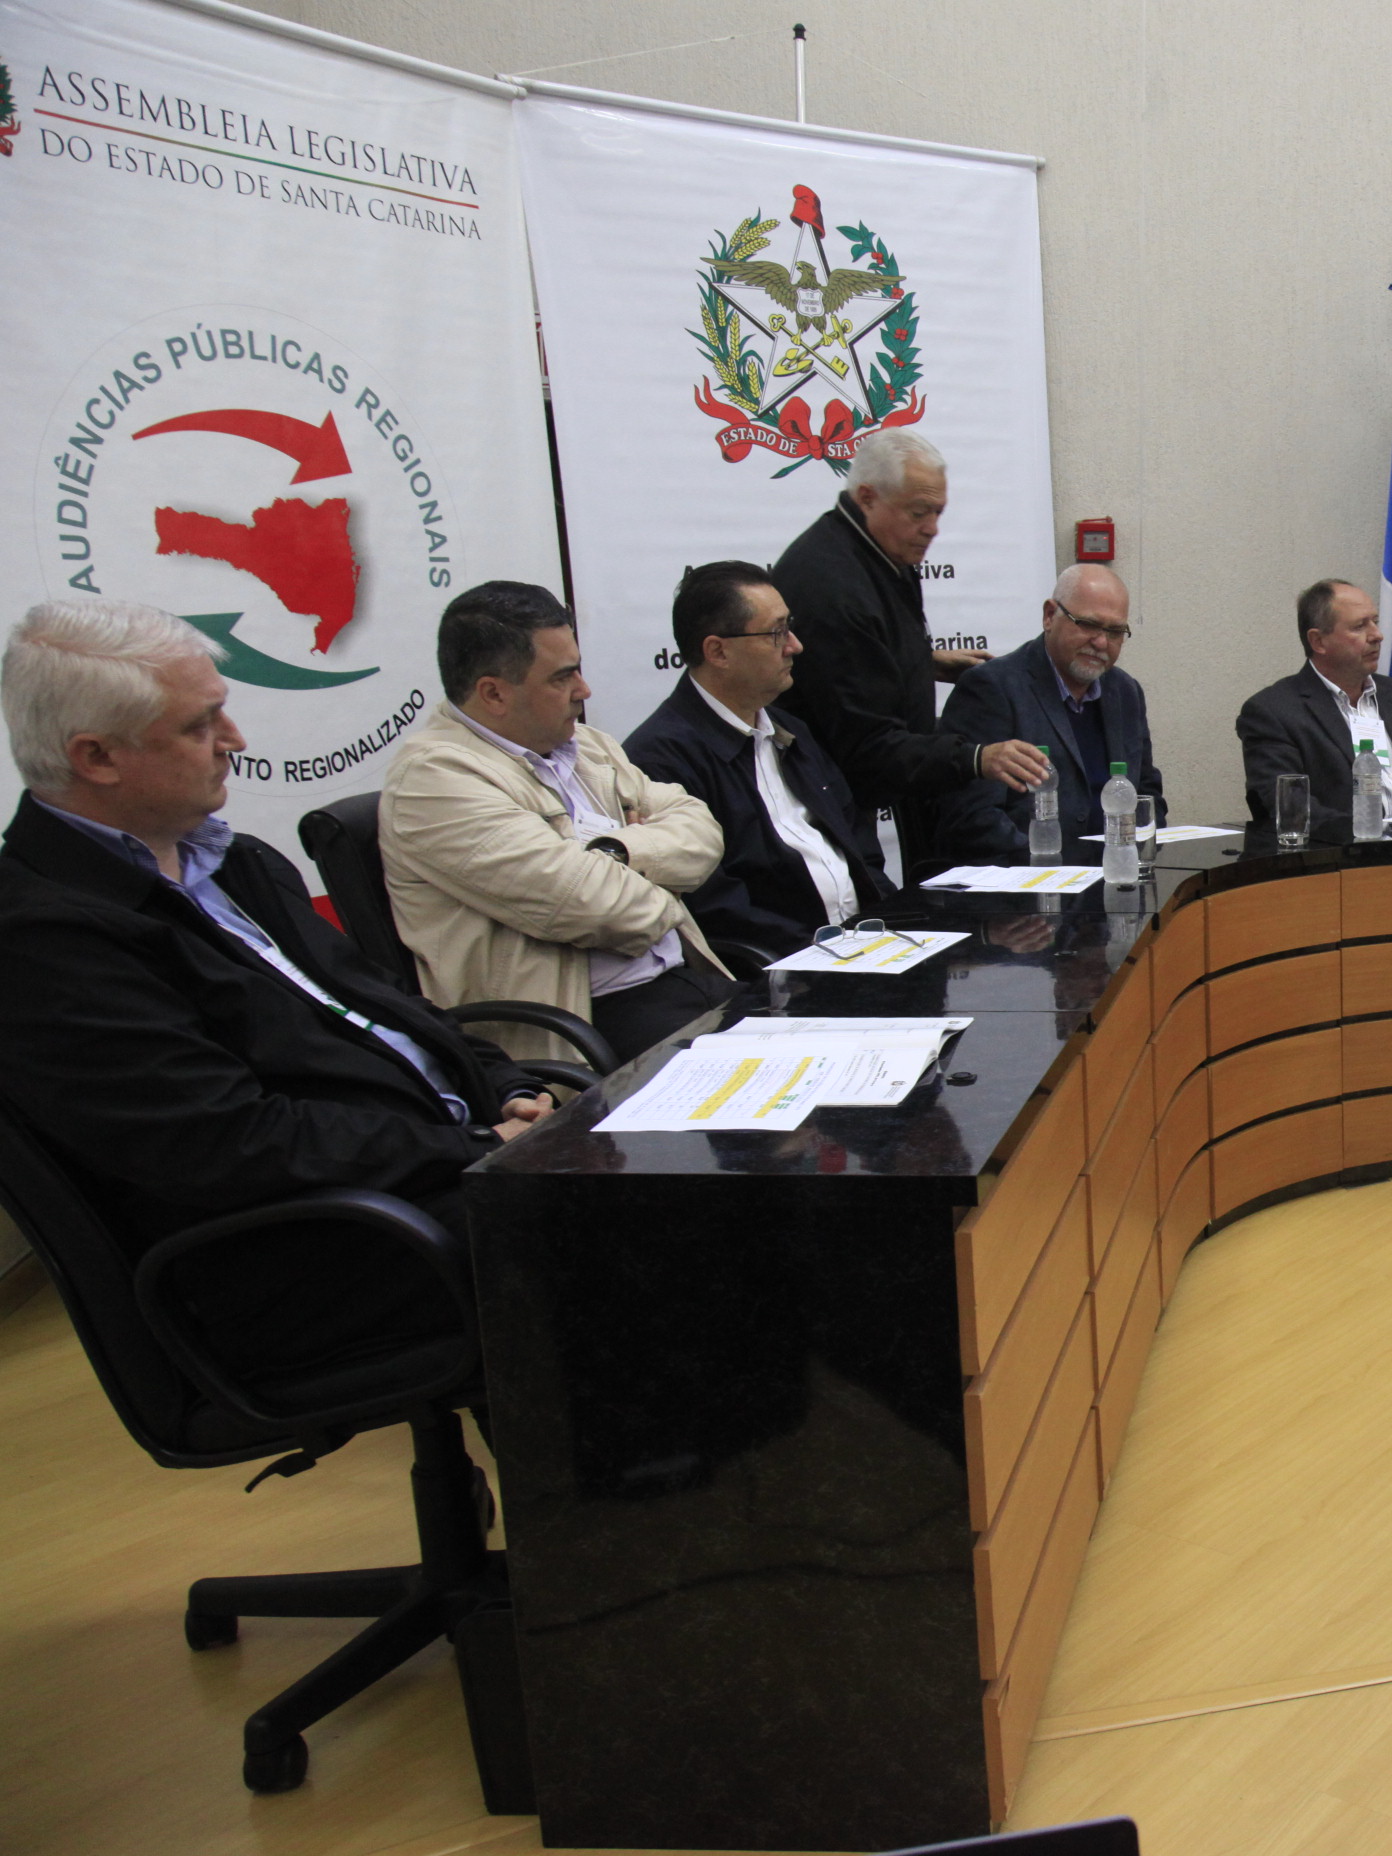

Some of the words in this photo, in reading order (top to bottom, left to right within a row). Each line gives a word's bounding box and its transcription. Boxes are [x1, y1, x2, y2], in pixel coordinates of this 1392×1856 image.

[38, 65, 277, 151] ASSEMBLEIA
[288, 125, 478, 195] LEGISLATIVA
[39, 128, 92, 163] DO
[106, 142, 224, 190] ESTADO
[234, 170, 271, 200] DE
[281, 179, 361, 218] SANTA
[368, 198, 482, 241] CATARINA
[56, 350, 163, 596] AUDIÊNCIAS
[165, 323, 352, 395] PÚBLICAS
[354, 386, 453, 589] REGIONAIS
[721, 428, 777, 446] ESTADO
[778, 439, 798, 455] DE
[284, 688, 425, 782] REGIONALIZADO
